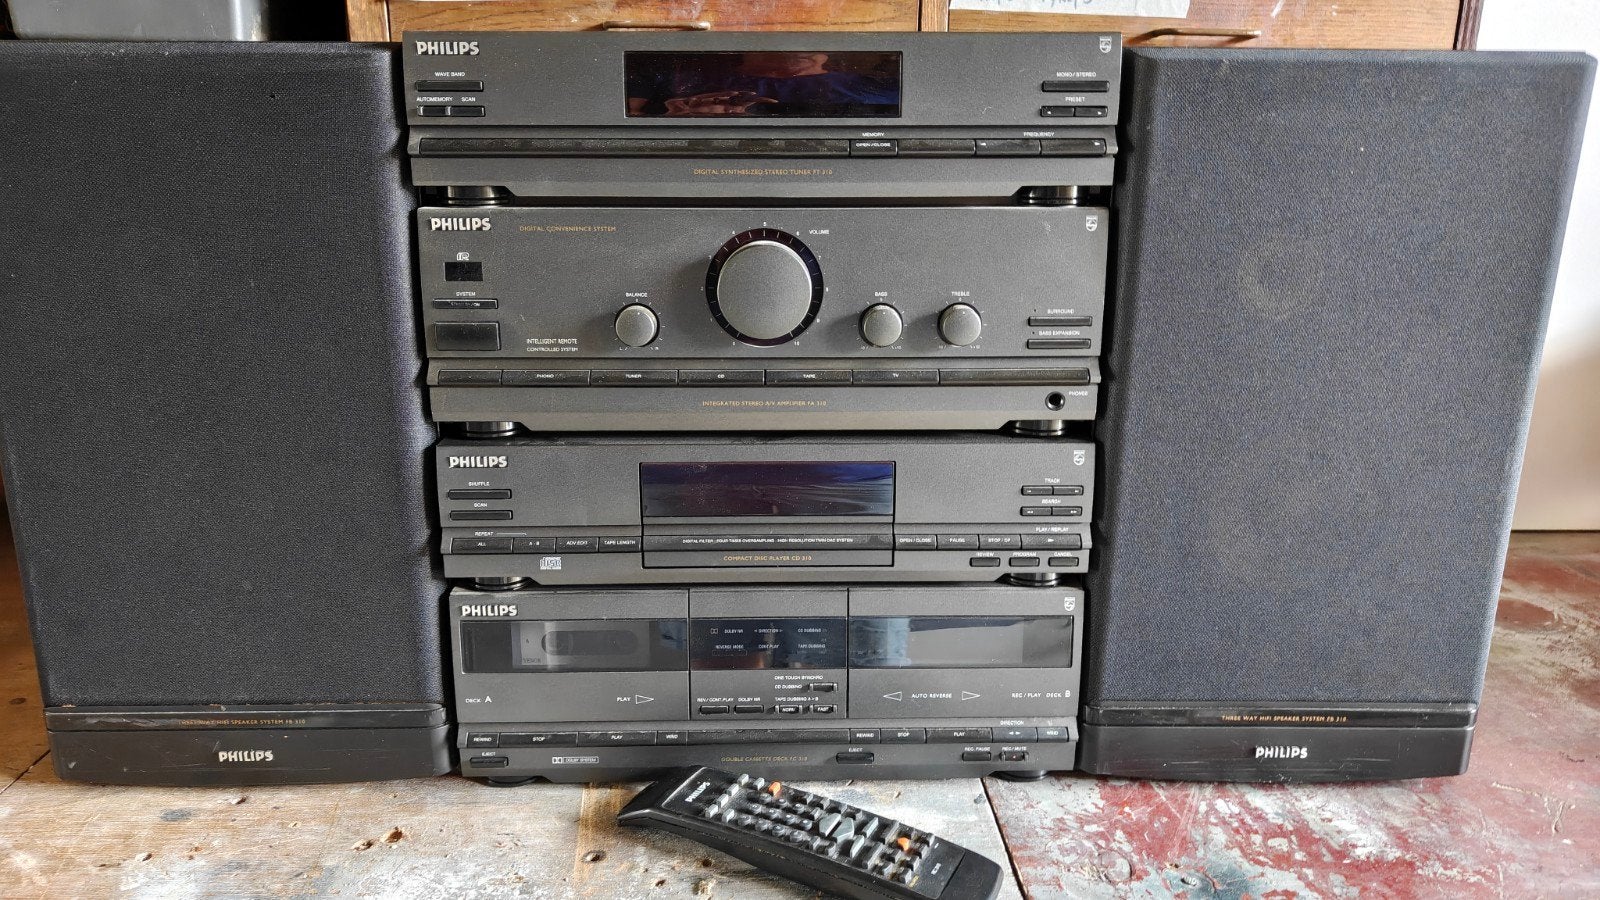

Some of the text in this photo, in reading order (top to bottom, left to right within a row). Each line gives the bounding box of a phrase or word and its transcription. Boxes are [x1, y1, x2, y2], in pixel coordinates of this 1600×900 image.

[416, 41, 479, 56] PHILIPS
[430, 217, 492, 232] PHILIPS
[449, 456, 508, 469] PHILIPS
[461, 604, 518, 617] PHILIPS
[484, 695, 492, 703] A
[1064, 690, 1071, 698] B
[218, 750, 274, 762] PHILIPS
[1254, 746, 1308, 759] PHILIPS
